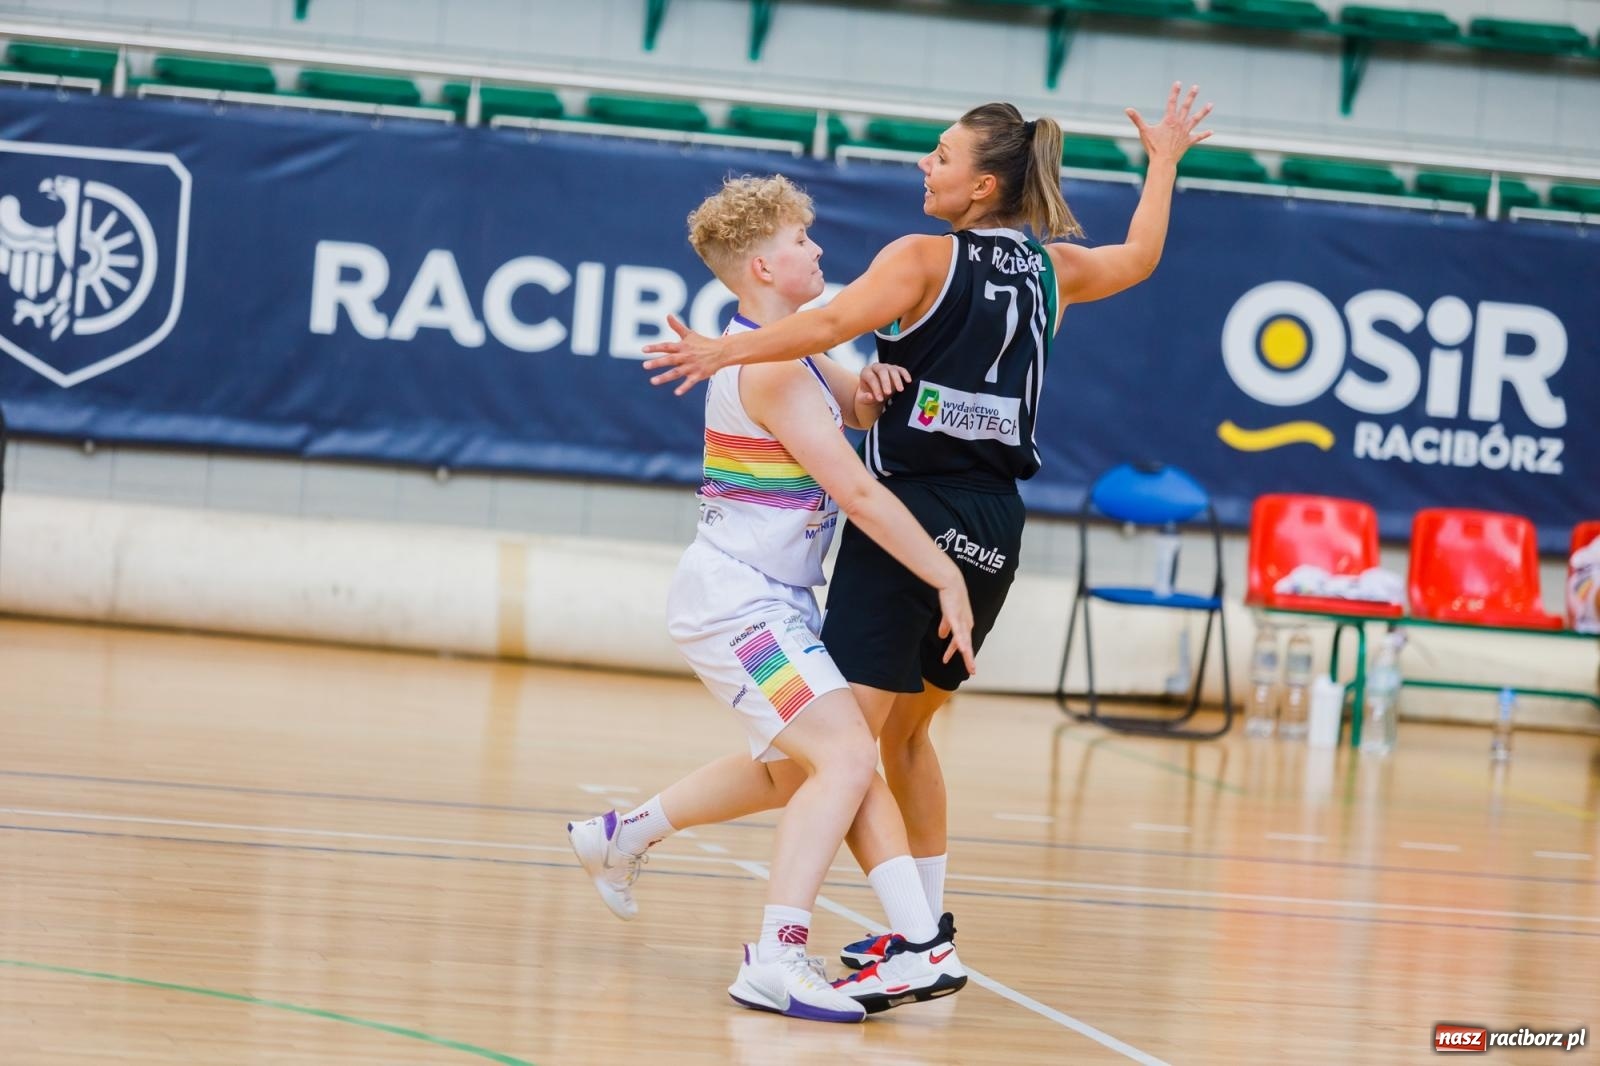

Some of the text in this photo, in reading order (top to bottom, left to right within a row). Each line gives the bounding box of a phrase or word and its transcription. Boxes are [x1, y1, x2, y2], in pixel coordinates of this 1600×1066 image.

[984, 279, 1019, 384] 7
[1221, 280, 1568, 429] OSiR
[1353, 421, 1565, 485] RACIBÓRZ
